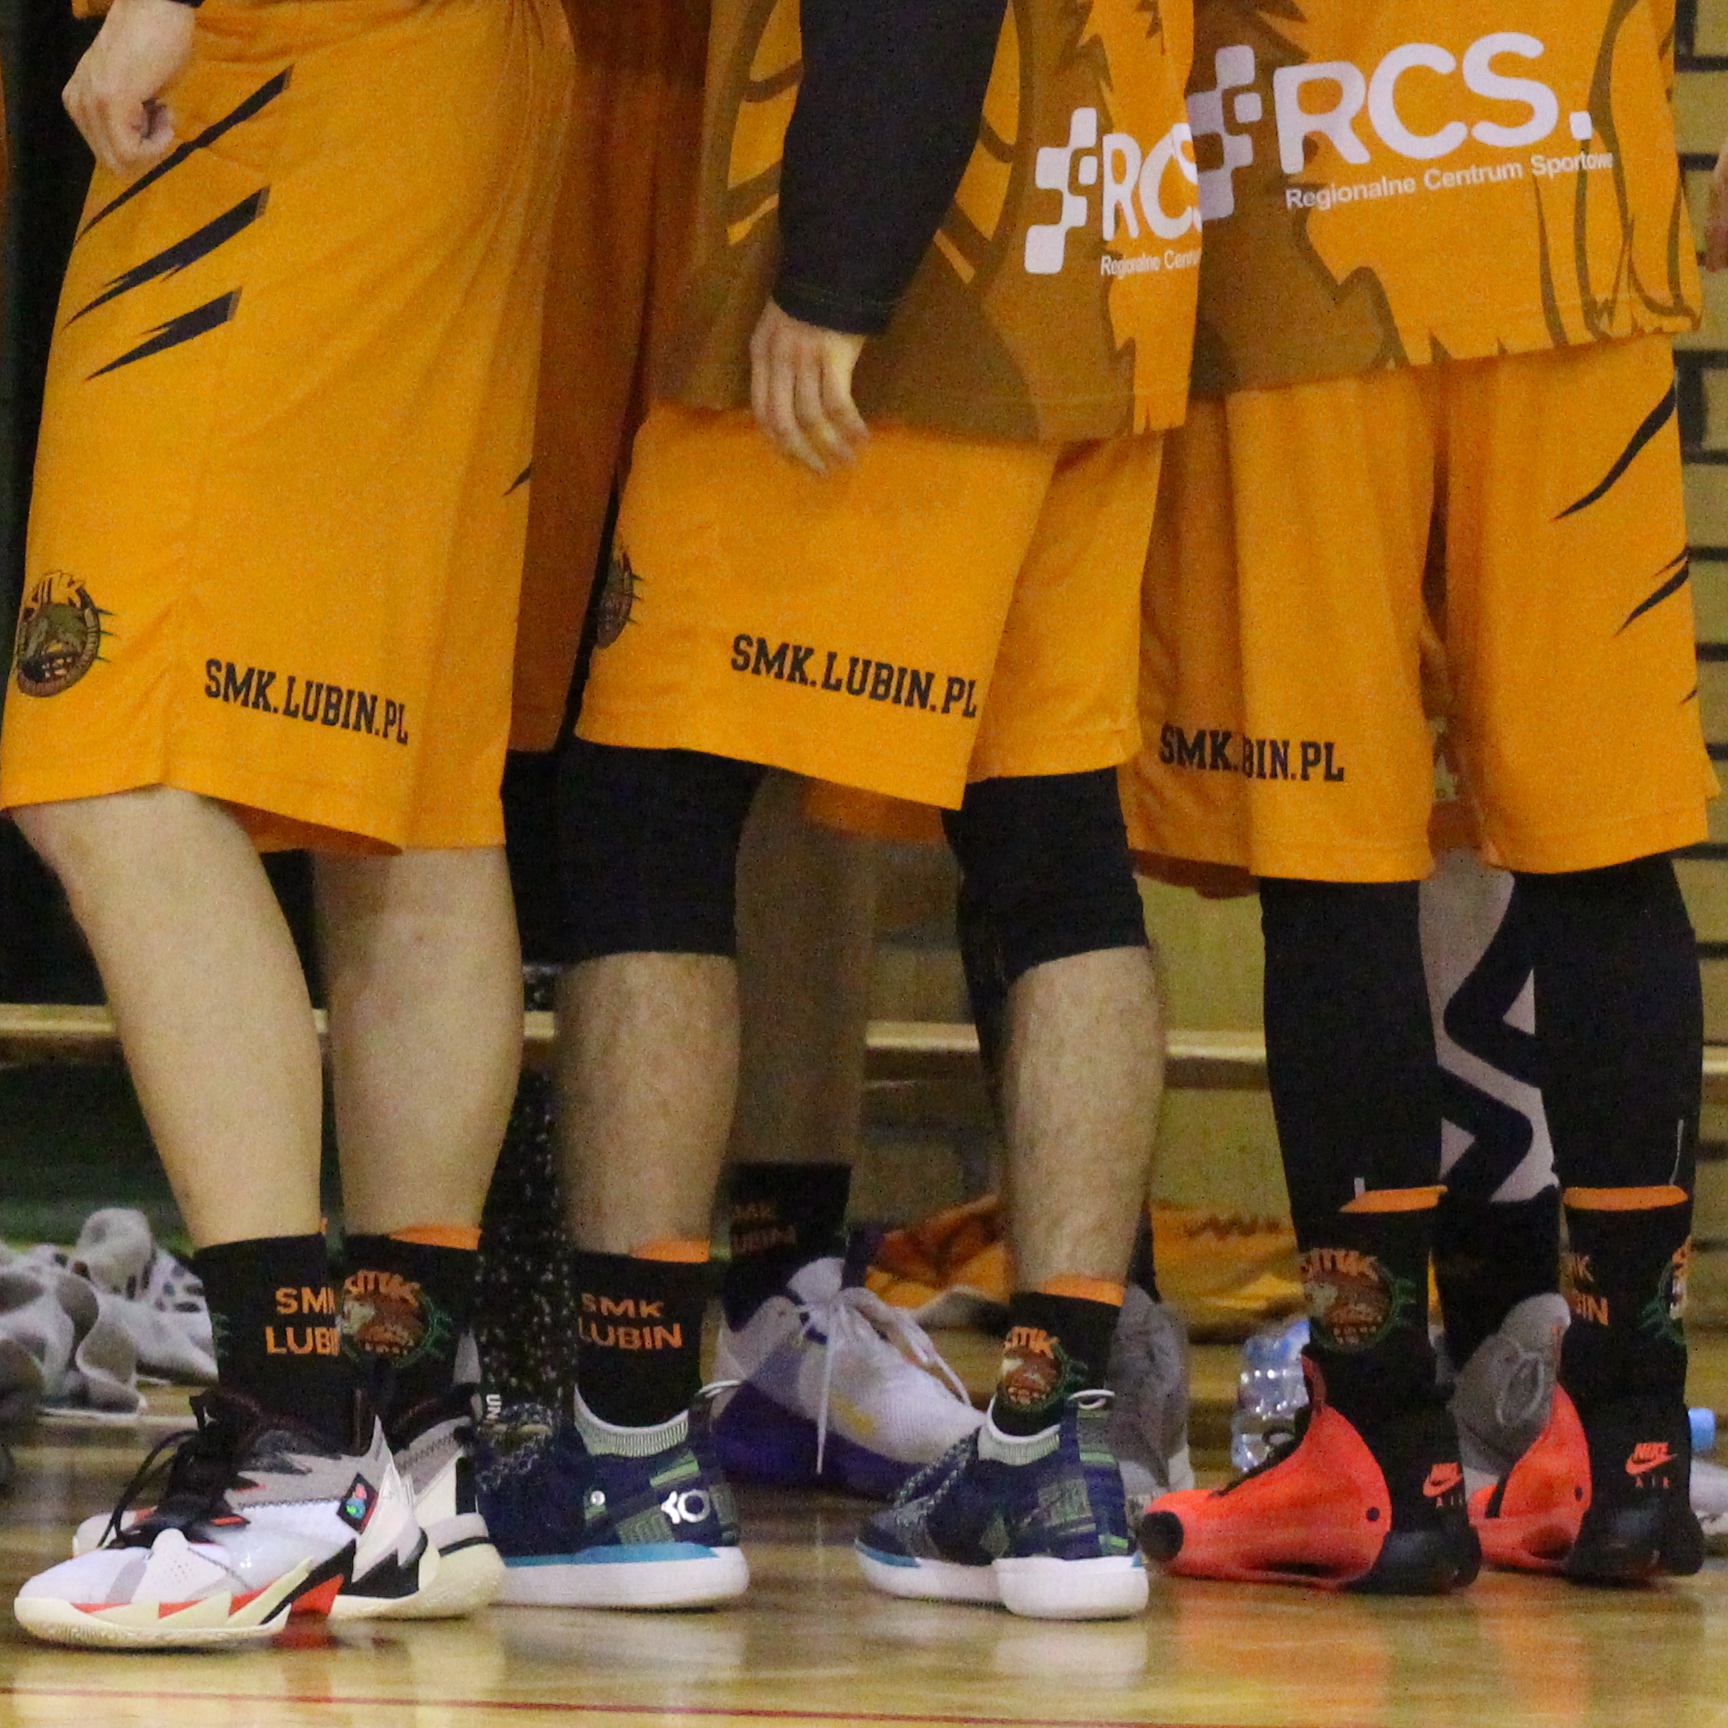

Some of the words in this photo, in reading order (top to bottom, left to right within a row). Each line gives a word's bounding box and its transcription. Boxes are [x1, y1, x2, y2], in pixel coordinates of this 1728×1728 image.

[1285, 176, 1416, 210] Regionalne
[1424, 160, 1523, 190] Centrum
[205, 658, 409, 745] SMK.LUBIN.PL
[731, 633, 977, 718] SMK.LUBIN.PL
